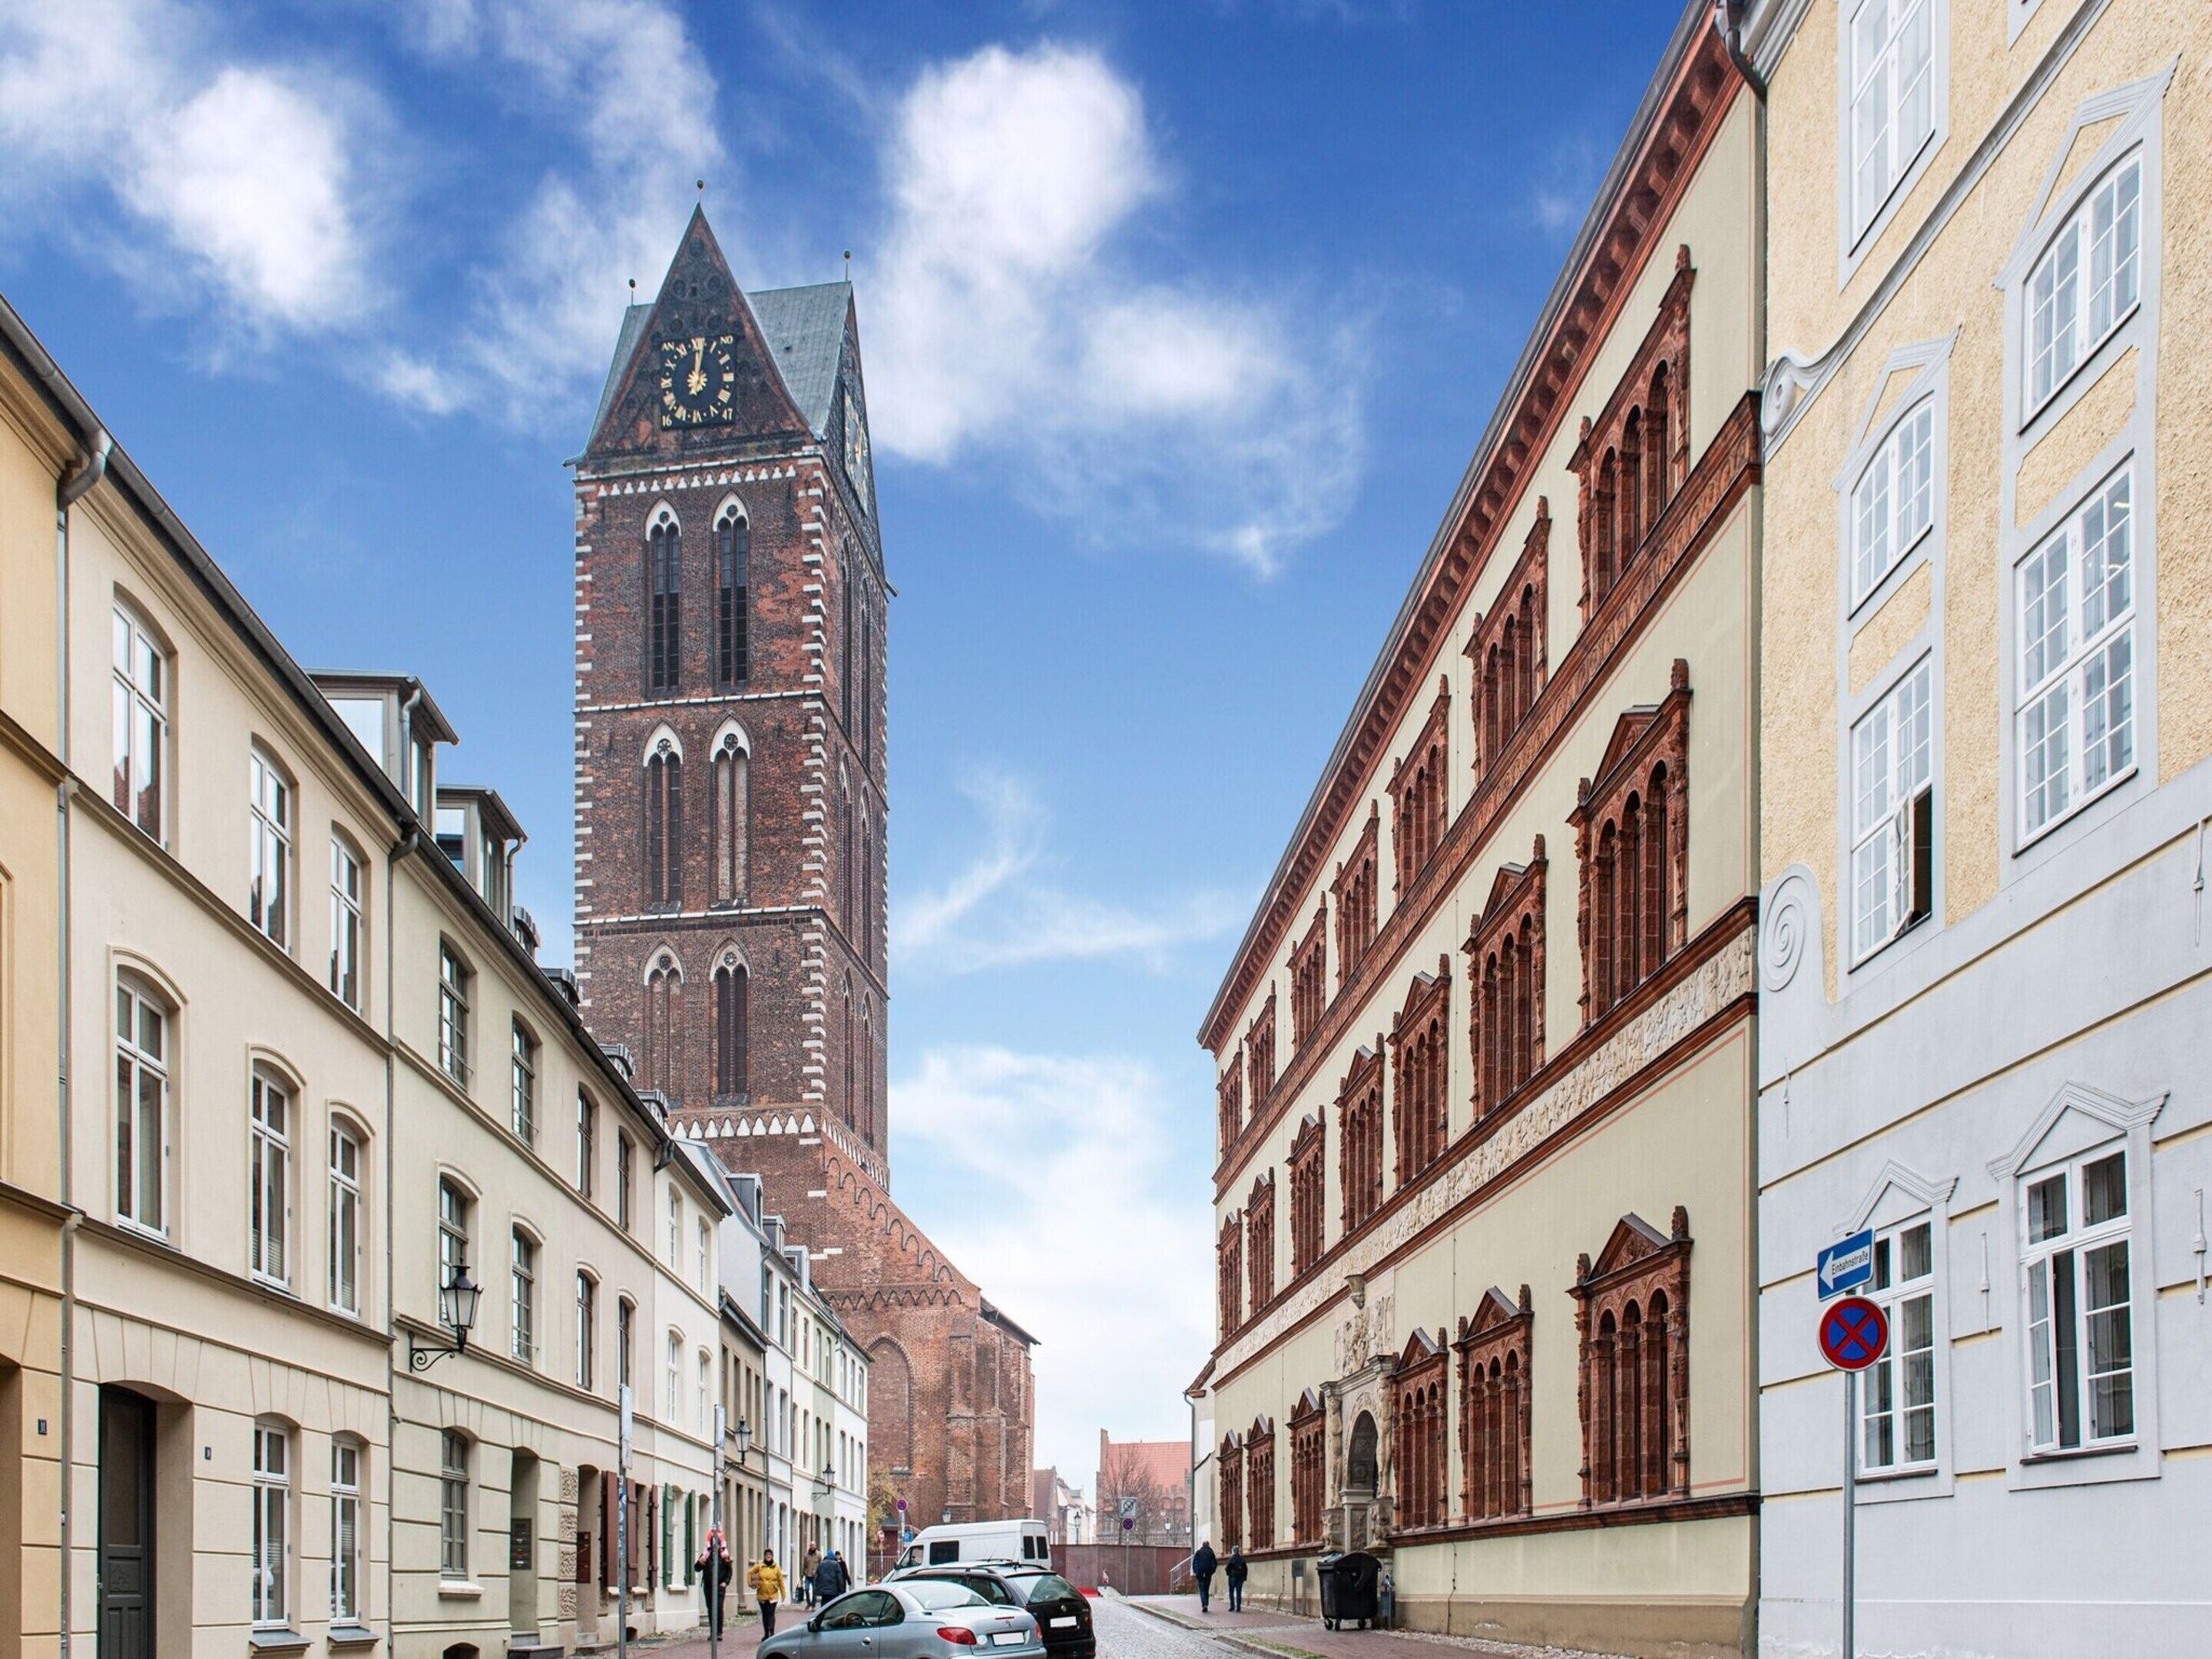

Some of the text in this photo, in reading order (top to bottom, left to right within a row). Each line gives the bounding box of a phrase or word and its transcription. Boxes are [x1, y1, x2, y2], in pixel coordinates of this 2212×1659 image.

[661, 341, 675, 351] AN
[662, 407, 733, 427] 16 47
[1831, 1250, 1869, 1276] Einbahnstraße
